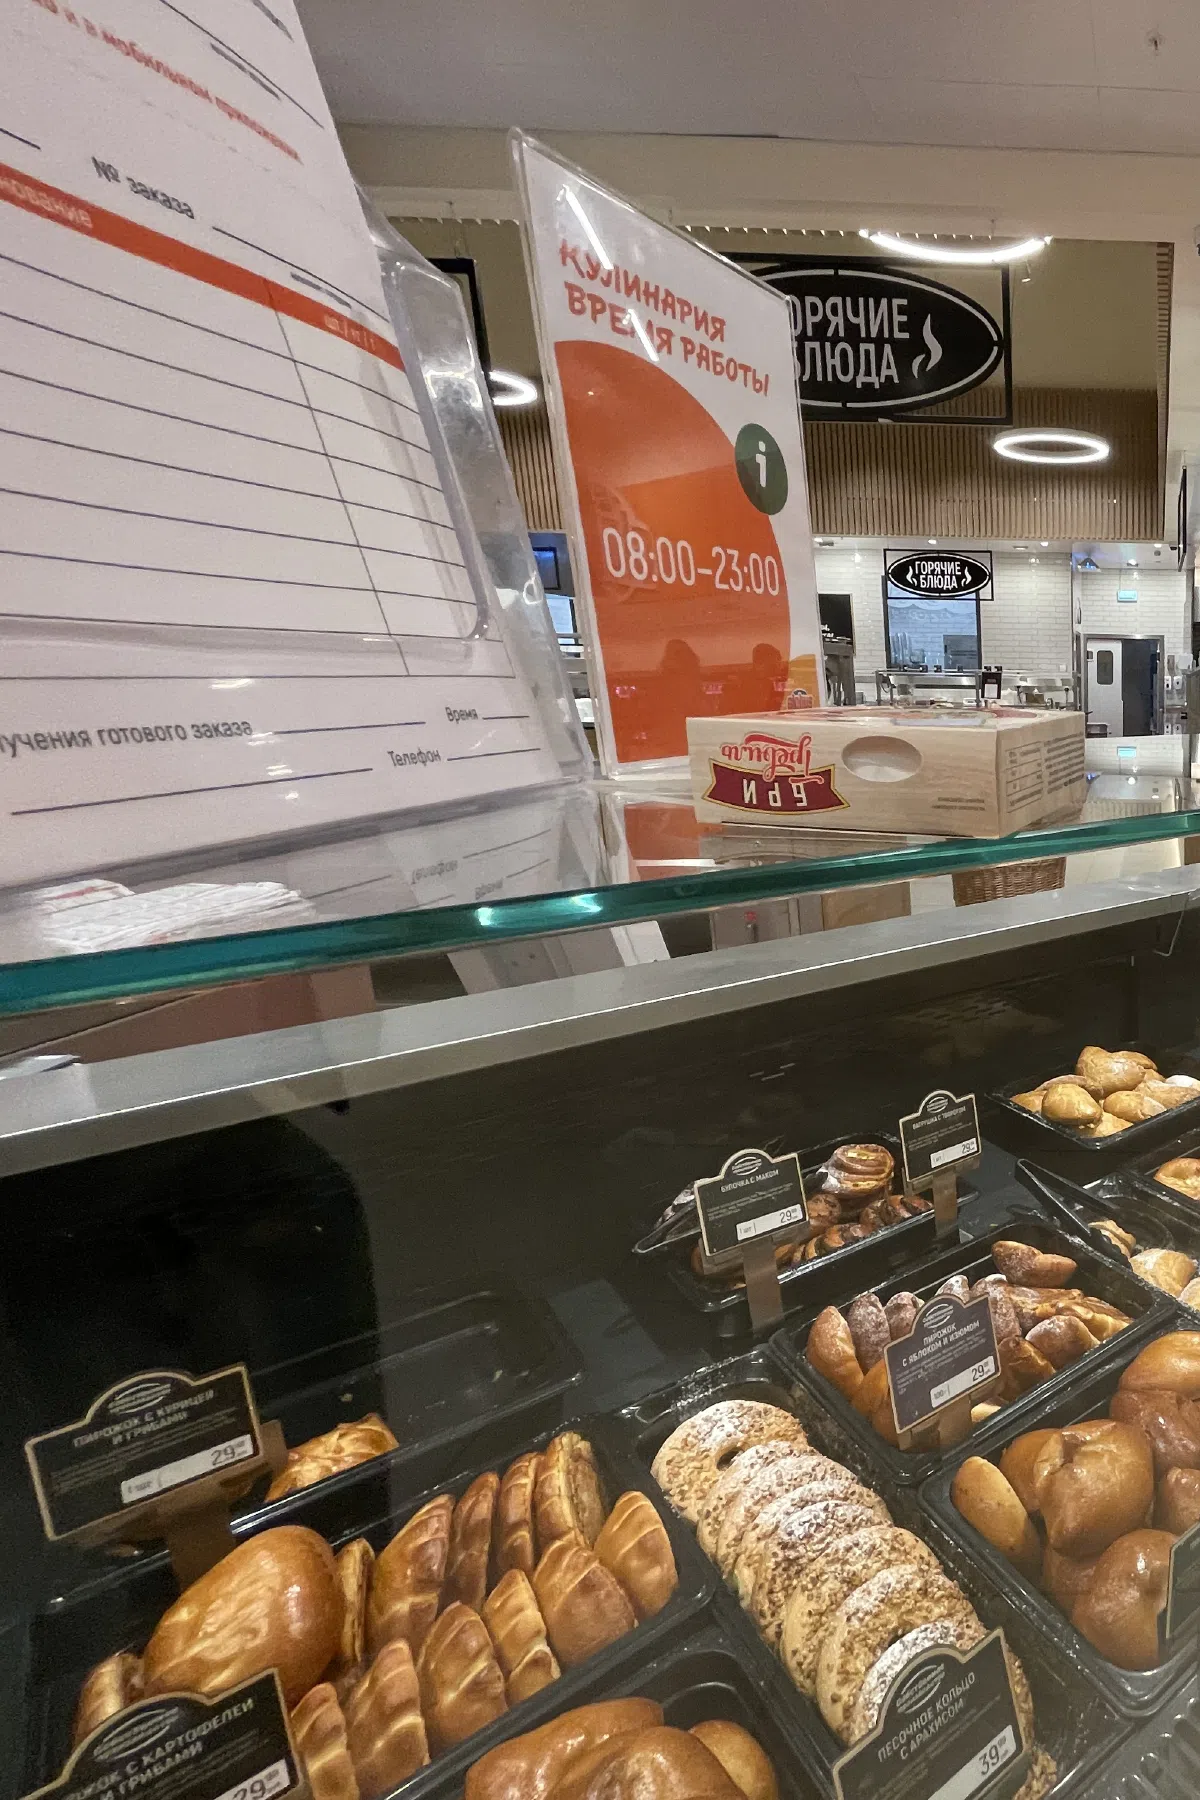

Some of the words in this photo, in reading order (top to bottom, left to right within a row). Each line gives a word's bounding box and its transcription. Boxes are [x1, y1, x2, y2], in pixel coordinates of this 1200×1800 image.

[126, 176, 195, 219] заказа
[559, 238, 726, 343] КУЛИНАРИЯ
[790, 295, 910, 339] ОРЯЧИЕ
[679, 335, 770, 396] РАБОТЫ
[915, 561, 962, 575] ГОРЯЧИЕ
[919, 575, 958, 591] БЛЮДА
[445, 706, 479, 725] Время
[97, 724, 188, 746] готового
[191, 720, 253, 739] заказа
[387, 747, 442, 767] Телефон
[742, 778, 808, 808] БРИ
[779, 1209, 792, 1224] 29
[902, 1358, 908, 1367] С
[908, 1340, 942, 1364] ЯБЛОКОМ
[949, 1320, 980, 1342] ИЗЮМОМ
[923, 1322, 957, 1346] ПИРОЖОК
[971, 1364, 985, 1382] 29
[210, 1444, 236, 1467] 29
[877, 1706, 935, 1763] ПЕСОЧНОЕ
[935, 1672, 976, 1713] КОЛЬЦО
[900, 1746, 909, 1760] С
[910, 1697, 964, 1753] АРАХИСОМ
[119, 1740, 204, 1795] ГРИБАМИ
[125, 1761, 139, 1774] С
[978, 1744, 1000, 1776] 39
